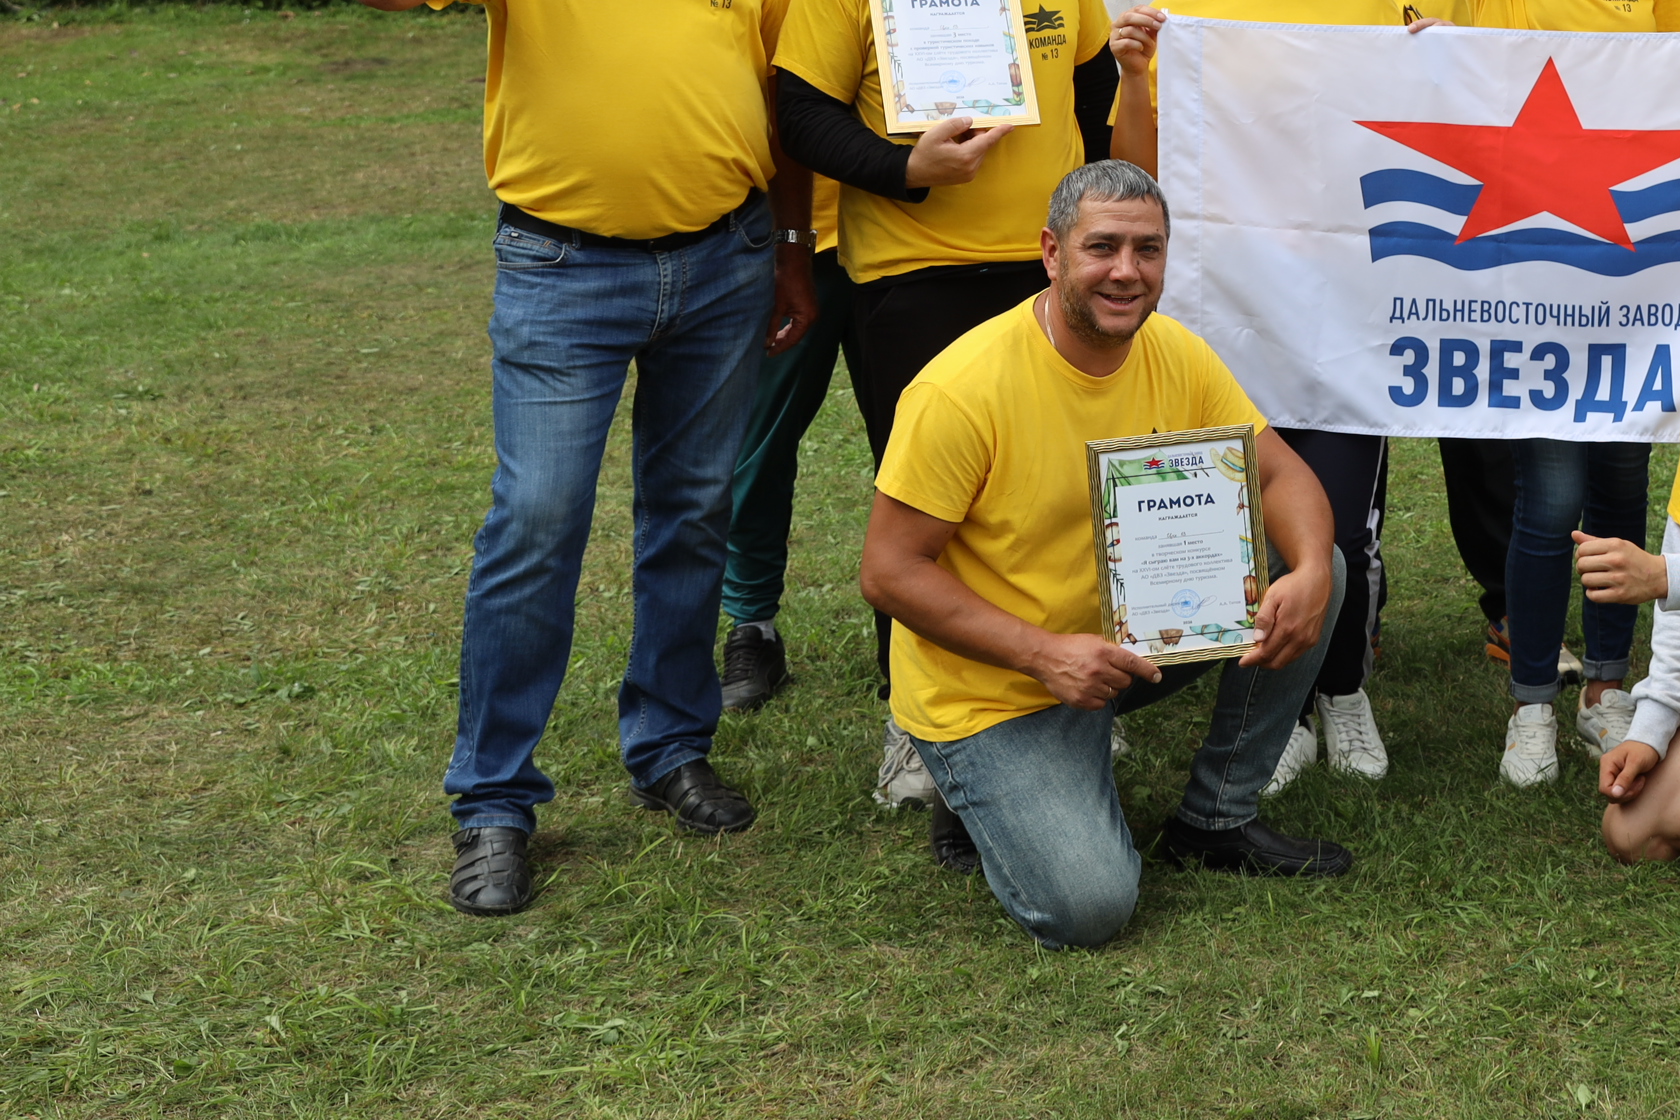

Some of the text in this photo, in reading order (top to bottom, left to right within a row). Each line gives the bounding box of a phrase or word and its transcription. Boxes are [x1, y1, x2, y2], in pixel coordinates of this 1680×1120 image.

[710, 0, 719, 8] №
[1622, 3, 1632, 13] 13
[1028, 34, 1067, 50] КОМАНДА
[1041, 48, 1059, 61] № 13
[1389, 295, 1611, 329] ДАЛЬНЕВОСТОЧНЫЙ
[1387, 336, 1677, 424] ЗВЕЗДА
[1168, 455, 1205, 469] ЗВЕЗДА
[1137, 492, 1216, 513] ГРАМОТА
[1158, 512, 1198, 521] НАГРАЖДАЕТСЯ
